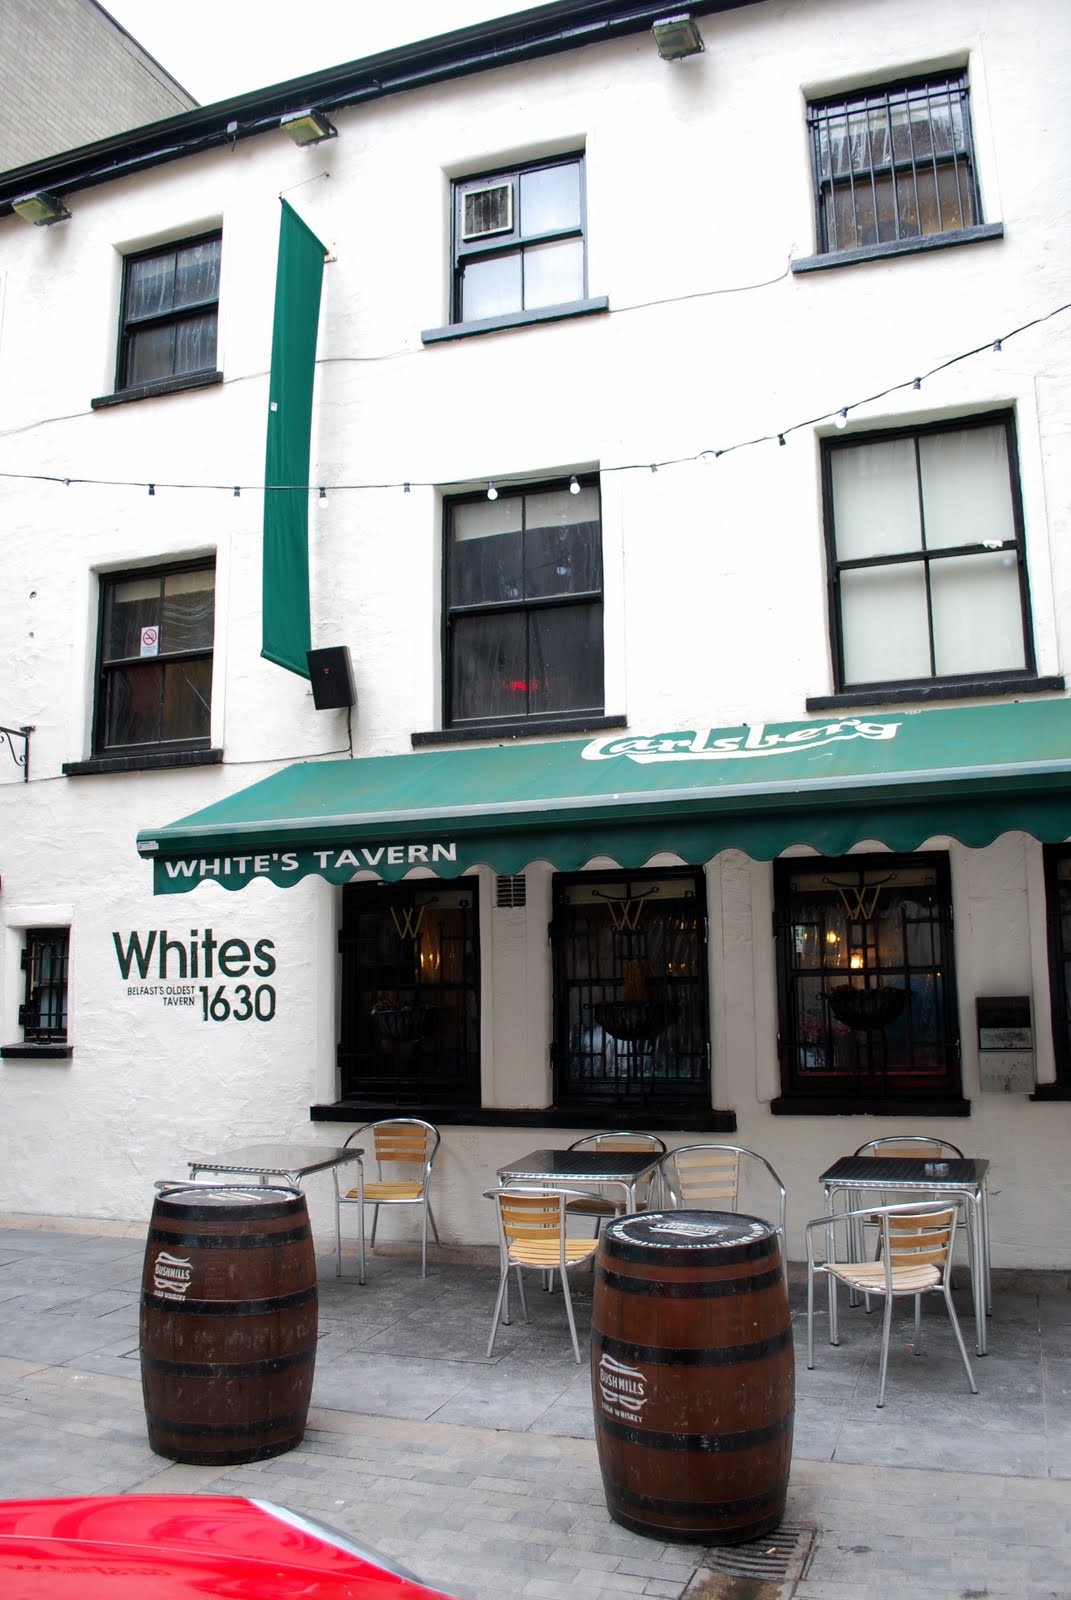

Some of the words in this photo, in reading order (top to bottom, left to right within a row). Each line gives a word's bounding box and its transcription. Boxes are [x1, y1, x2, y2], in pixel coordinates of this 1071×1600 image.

[581, 717, 902, 763] Carlsberg
[165, 852, 299, 878] WHITE'S
[313, 842, 457, 869] TAVERN
[112, 928, 276, 980] Whites
[127, 985, 165, 996] BELFAST'S
[166, 985, 195, 995] OLDEST
[163, 996, 195, 1006] TAVERN
[199, 984, 276, 1022] 1630
[154, 1263, 191, 1280] BUSHMILLS
[600, 1369, 644, 1396] BUSHMILLS
[614, 1408, 643, 1423] WHISKEY
